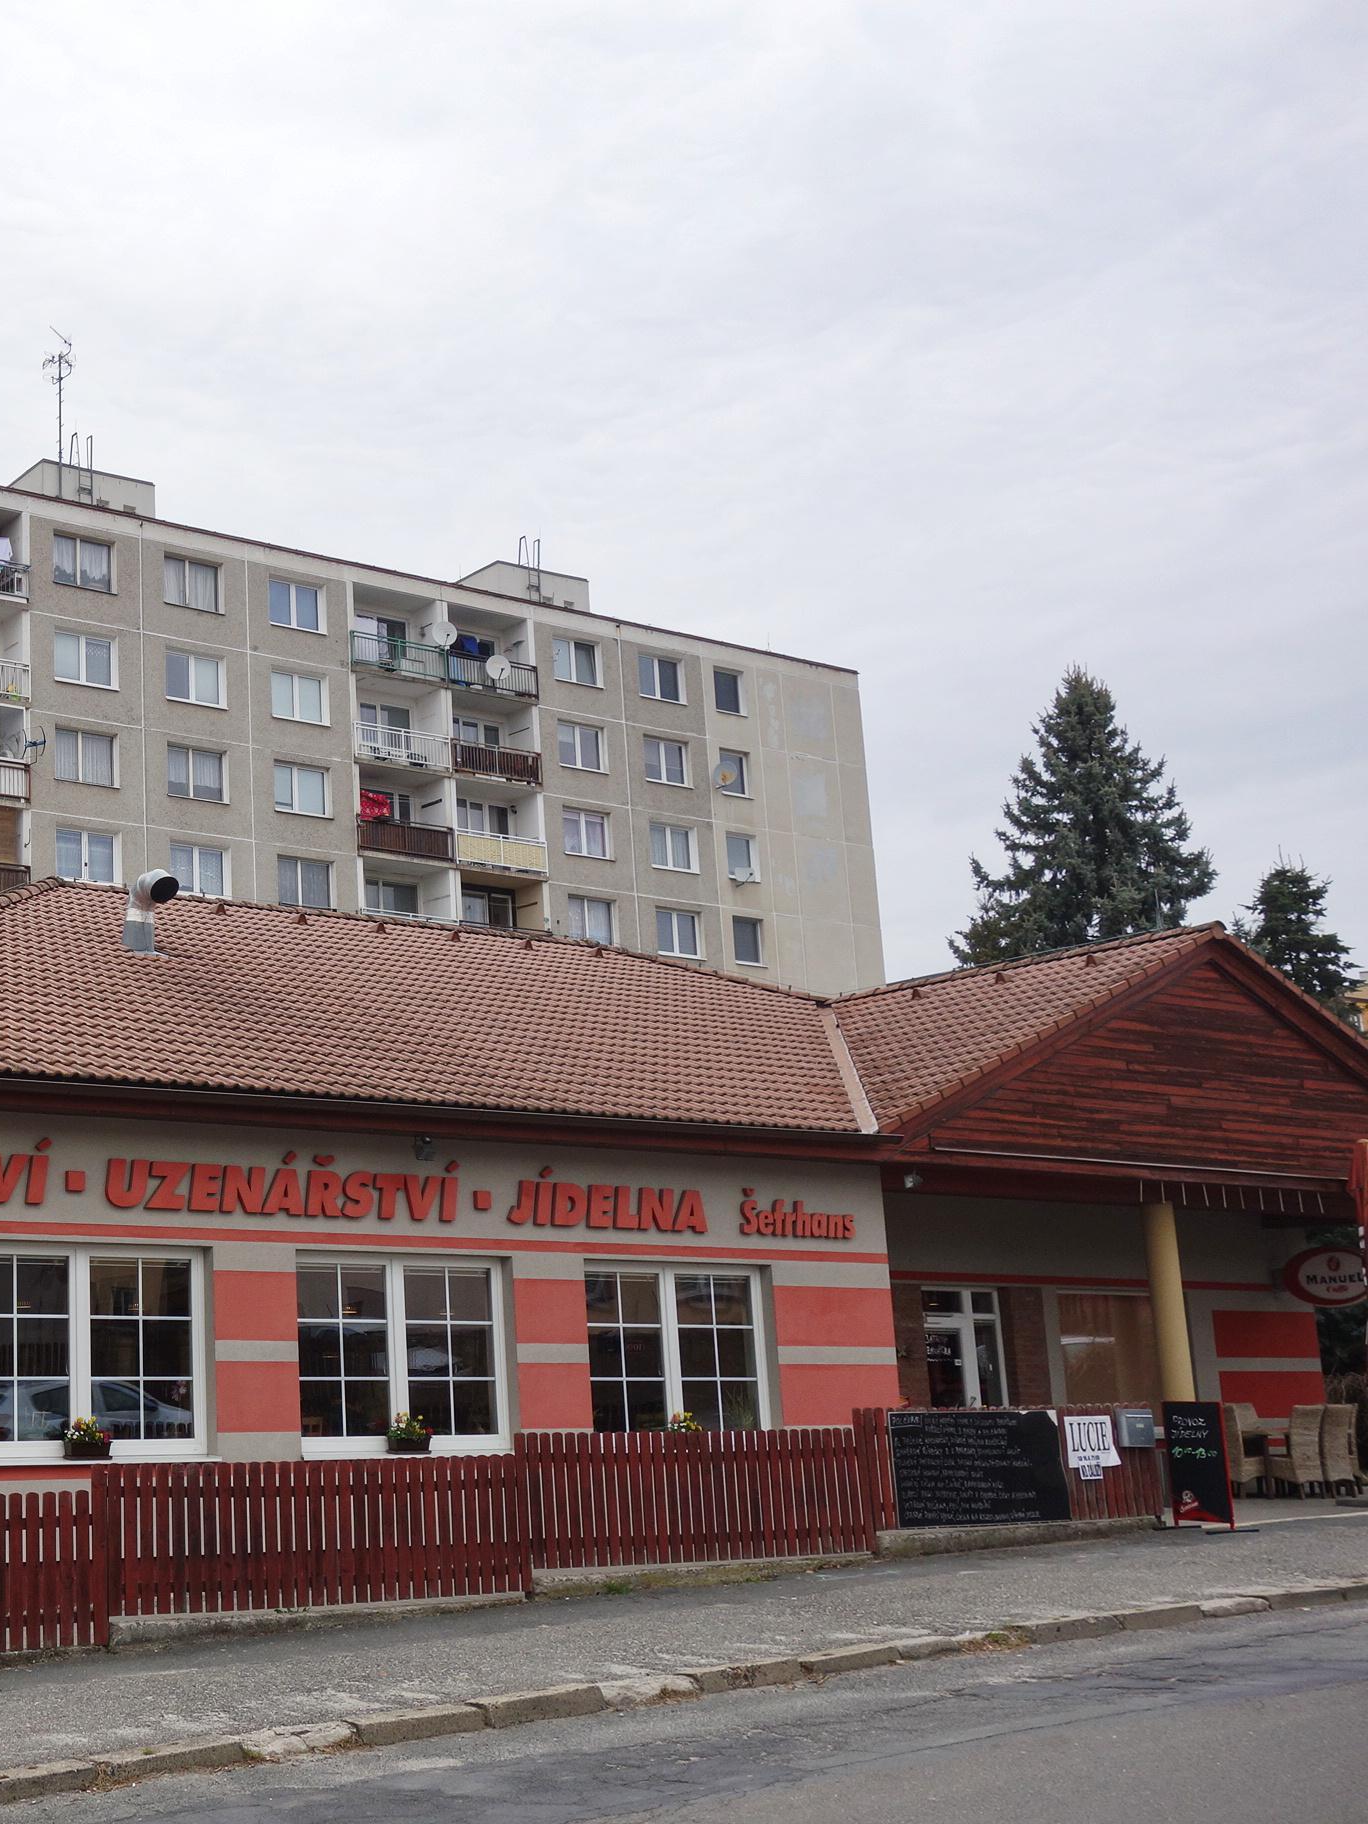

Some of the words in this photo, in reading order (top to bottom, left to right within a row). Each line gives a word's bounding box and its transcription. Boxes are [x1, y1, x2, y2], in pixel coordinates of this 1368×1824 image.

[104, 1150, 460, 1223] UZENÁŘSTVÍ
[506, 1166, 708, 1234] JÍDELNA
[739, 1187, 856, 1240] Šefrhans
[1069, 1421, 1110, 1452] LUCIE
[1172, 1415, 1207, 1427] PROVOZ
